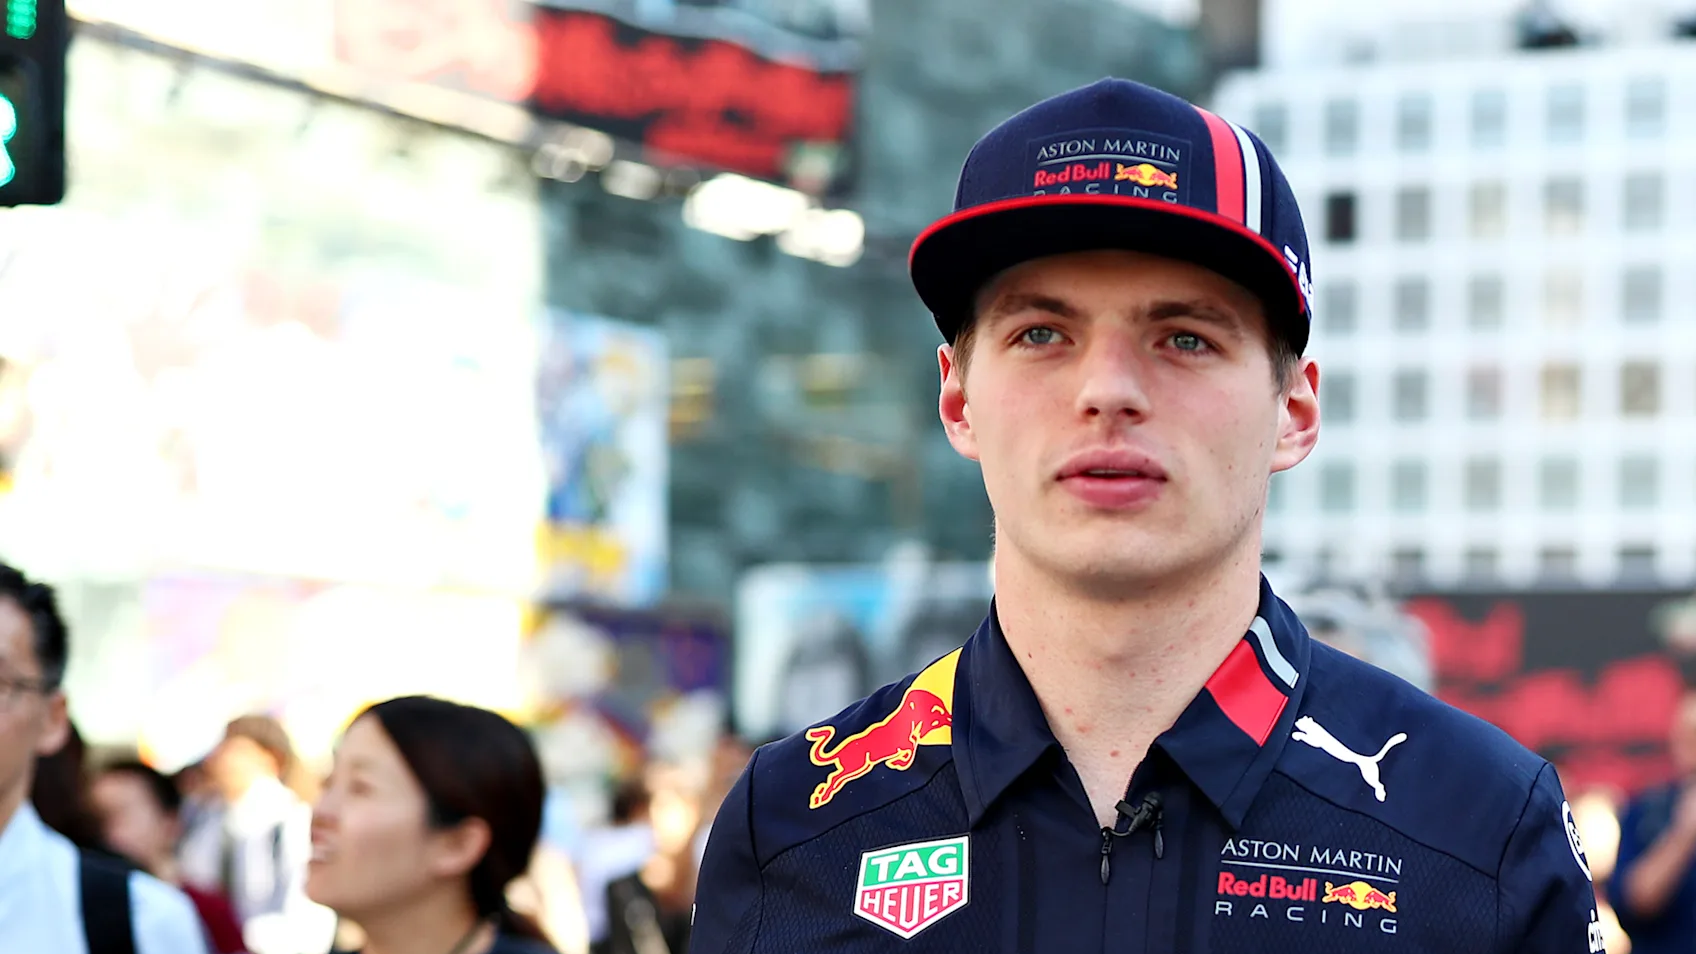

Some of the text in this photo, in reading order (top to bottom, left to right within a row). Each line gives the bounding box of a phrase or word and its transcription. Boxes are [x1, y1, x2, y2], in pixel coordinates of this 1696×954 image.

[1037, 139, 1180, 161] ASTON MARTIN
[870, 846, 957, 882] TAG
[1221, 838, 1402, 875] ASTON MARTIN
[863, 882, 960, 929] HEUER
[1215, 901, 1397, 934] RACING
